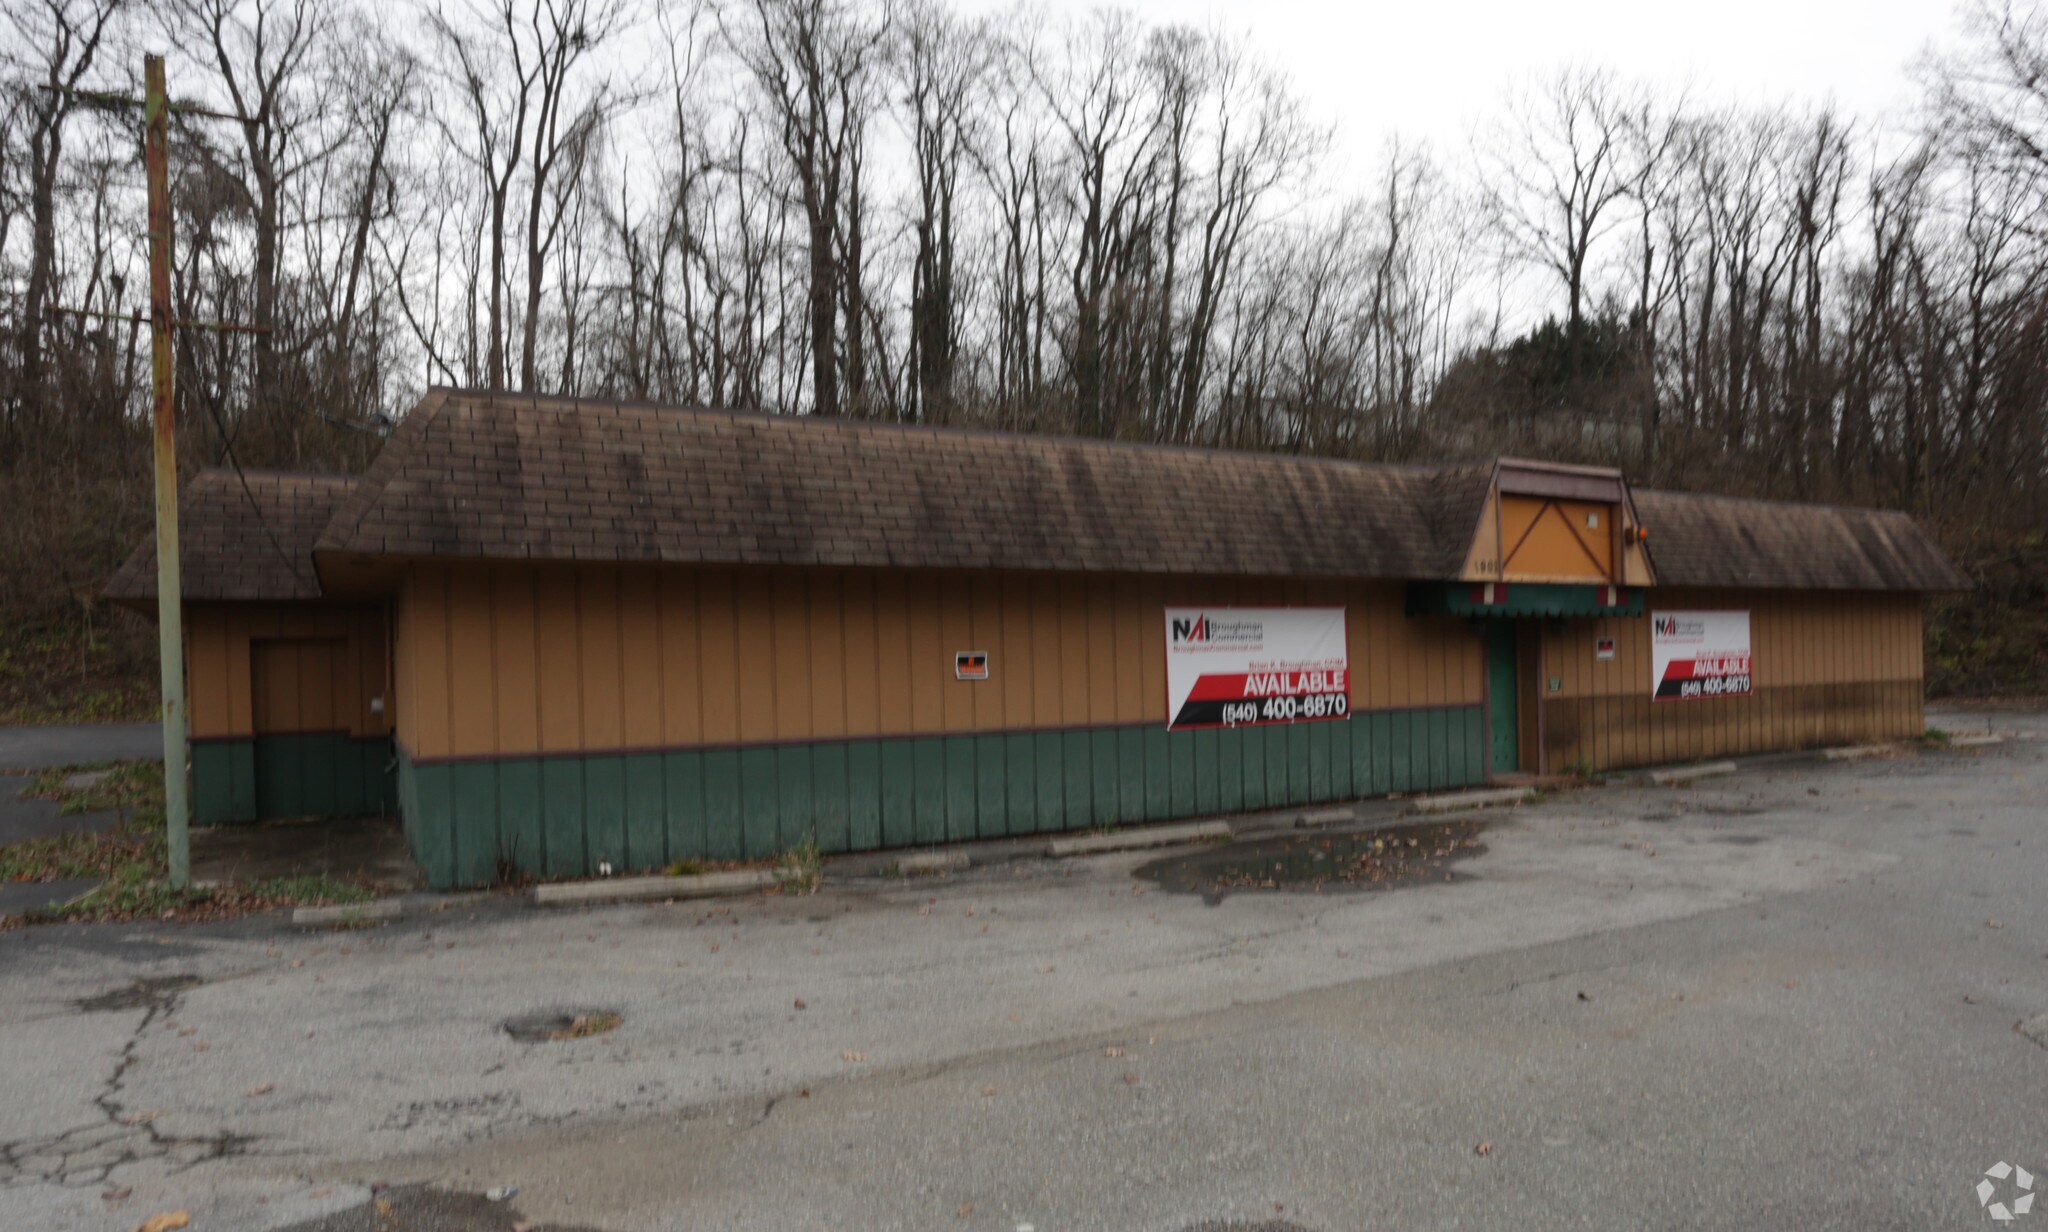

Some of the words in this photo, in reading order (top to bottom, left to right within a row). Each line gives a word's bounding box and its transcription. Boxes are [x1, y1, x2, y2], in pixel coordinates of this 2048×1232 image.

[1173, 612, 1210, 643] NAI
[1655, 614, 1676, 637] NAI
[1693, 658, 1750, 677] AVAILABLE
[1244, 671, 1345, 697] AVAILABLE
[1222, 702, 1258, 724] (540)
[1263, 693, 1346, 720] 400-6870
